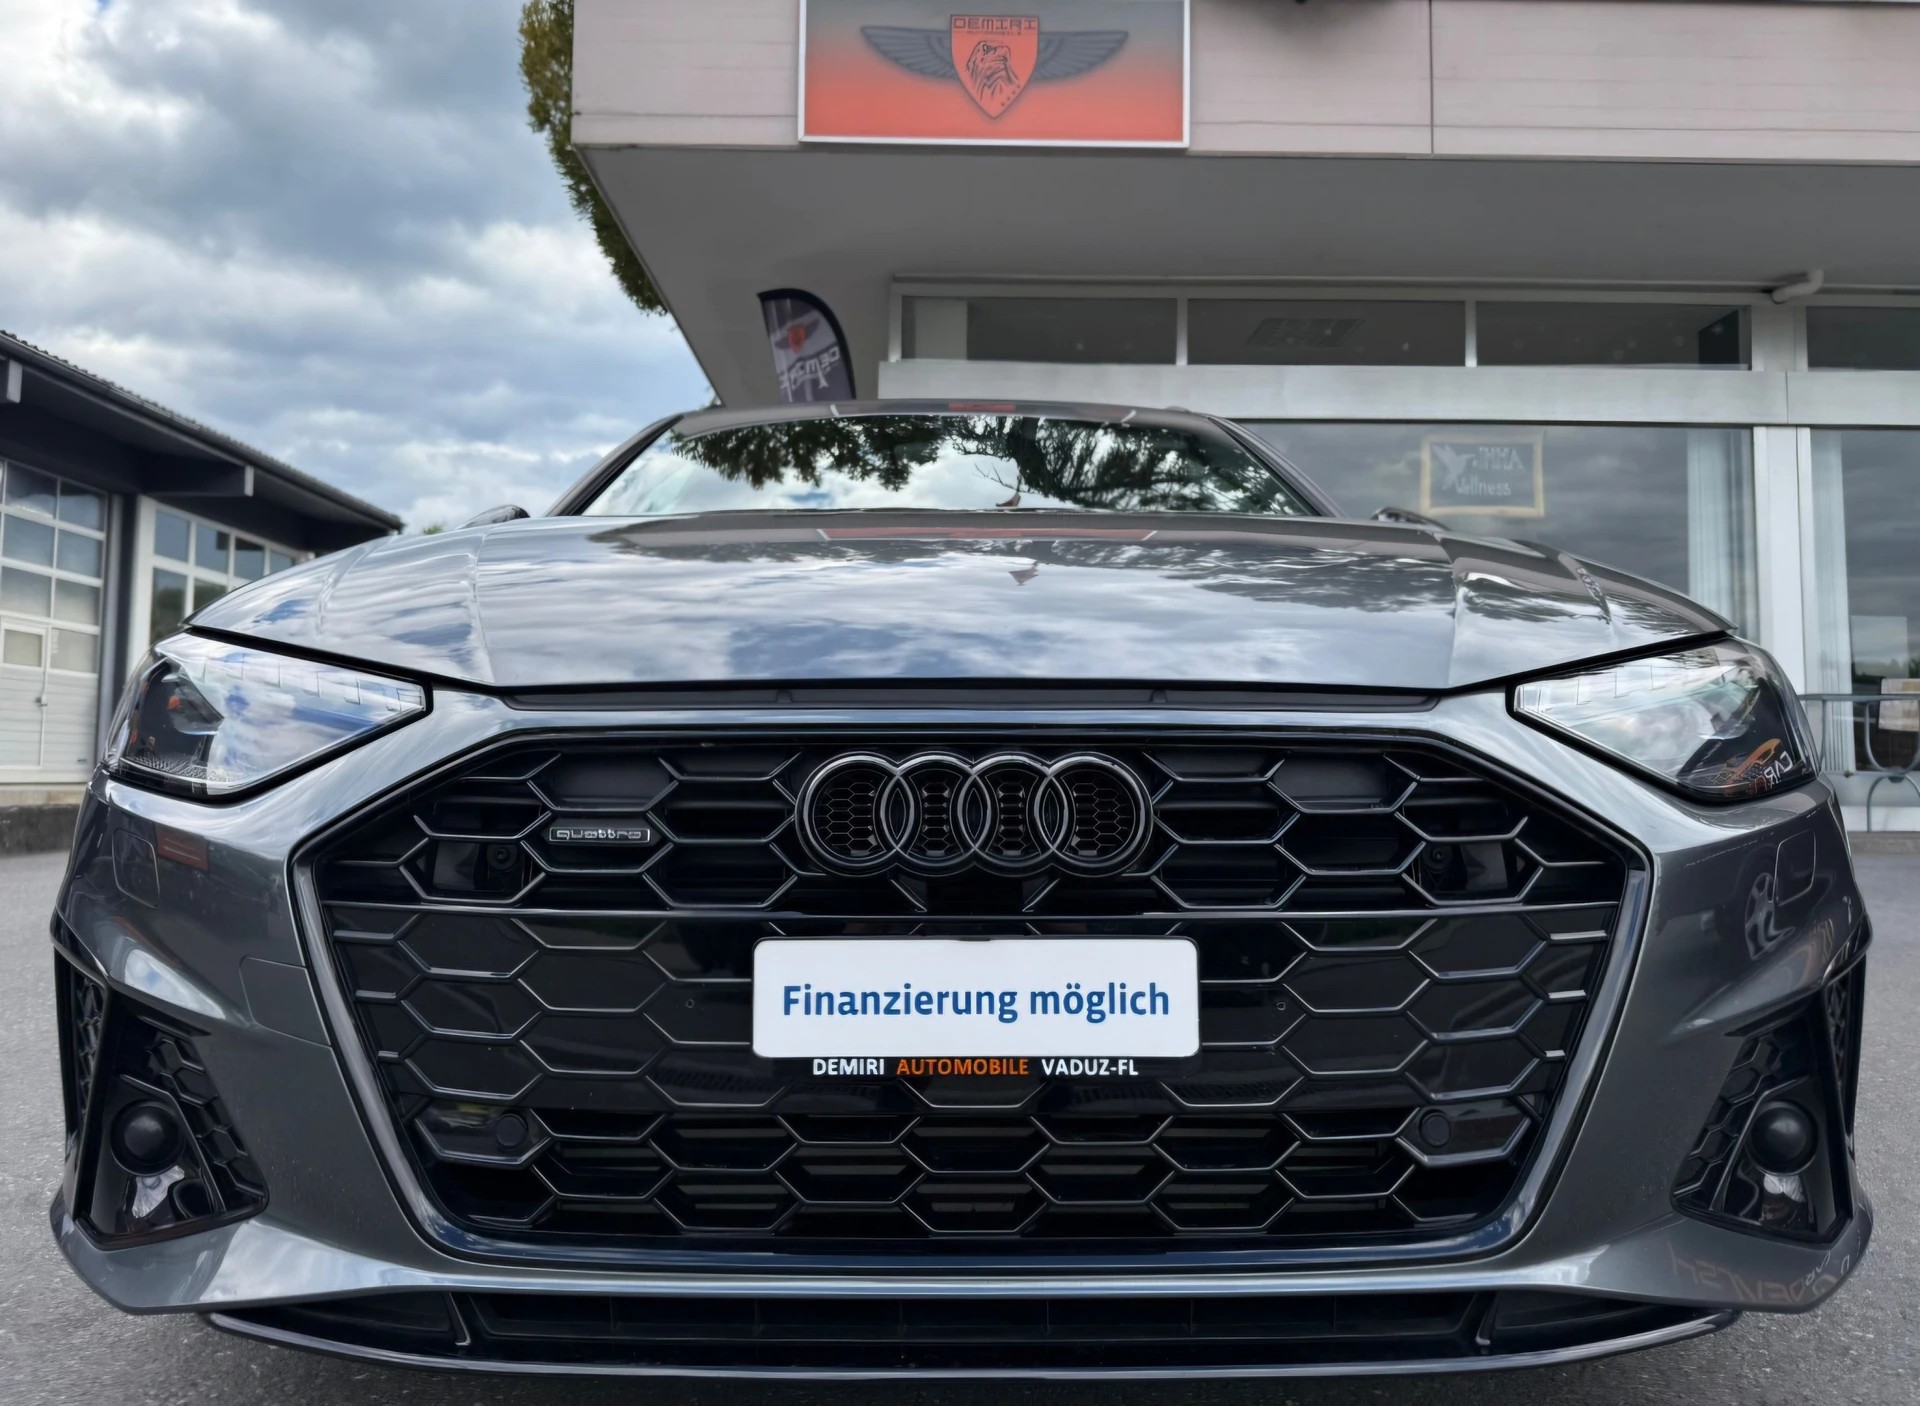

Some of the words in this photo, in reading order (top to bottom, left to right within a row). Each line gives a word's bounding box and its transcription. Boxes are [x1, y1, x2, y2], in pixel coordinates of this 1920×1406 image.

[953, 17, 1037, 30] DEMIRI
[556, 829, 642, 841] quattro
[783, 983, 1018, 1023] Finanzierung
[1030, 982, 1170, 1023] möglich
[812, 1058, 885, 1076] DEMIRI
[896, 1058, 1029, 1076] AUTOMOBILE
[1041, 1058, 1139, 1076] VADUZ-FL
